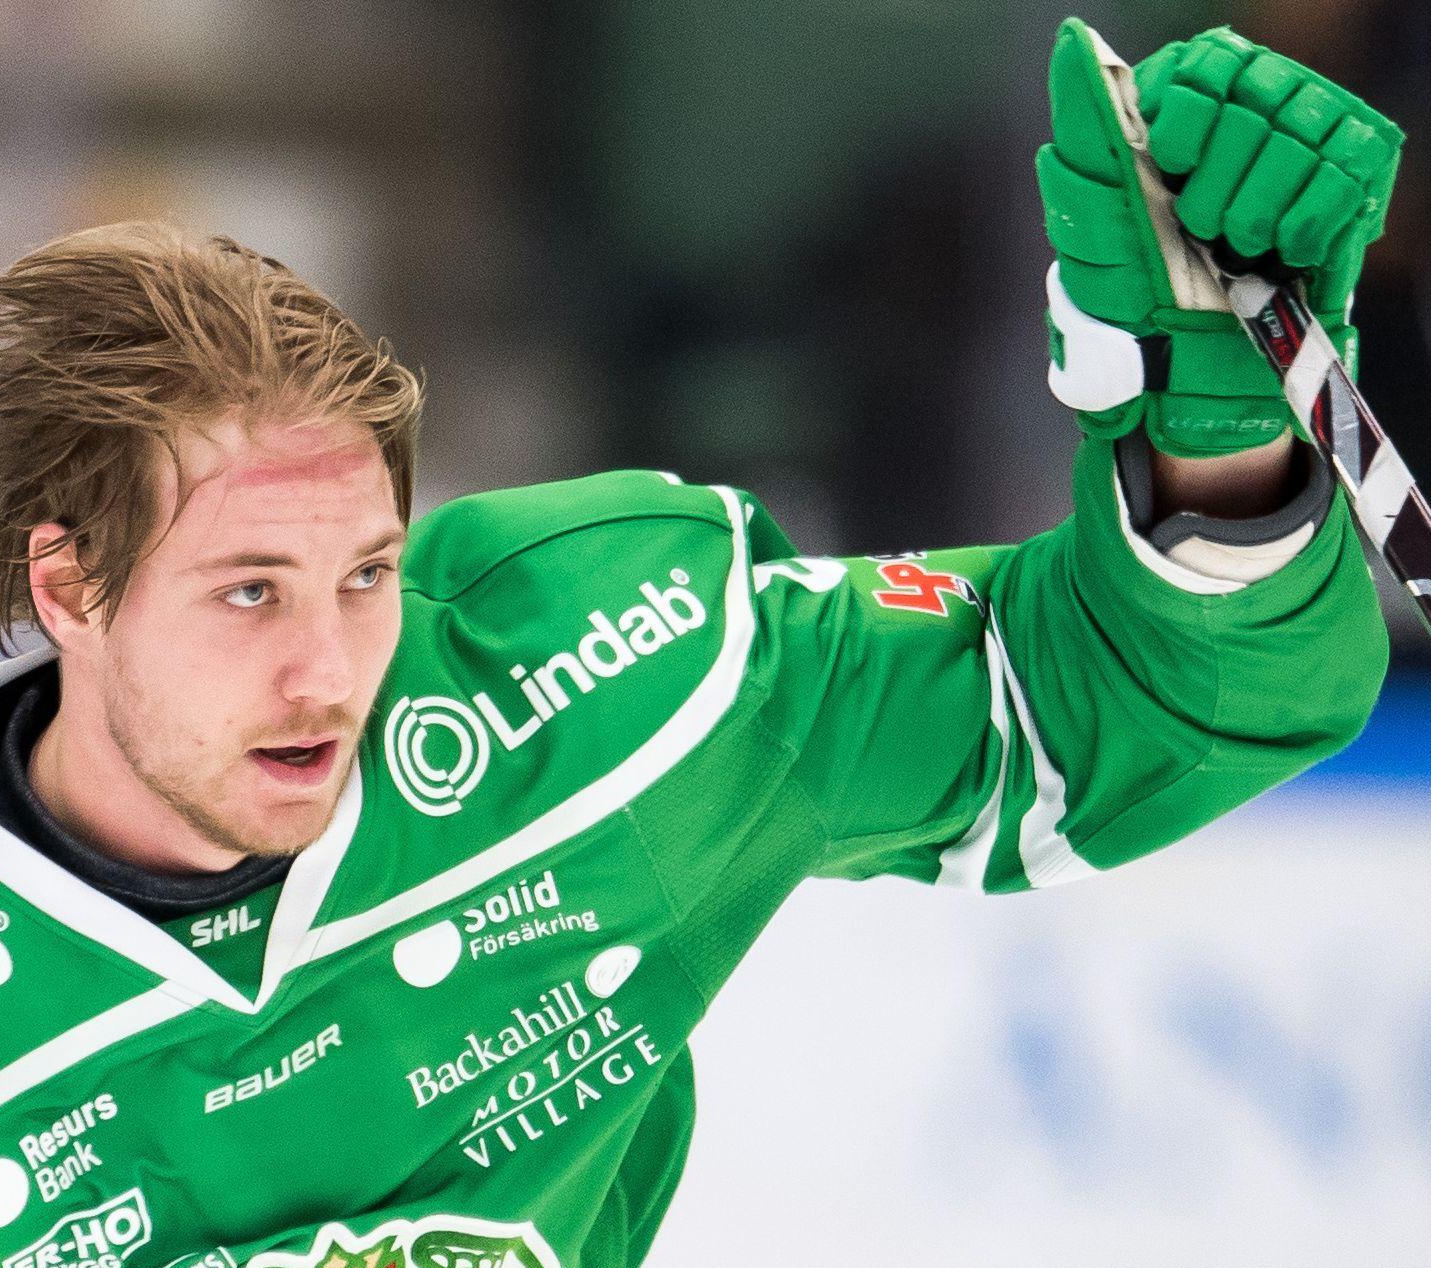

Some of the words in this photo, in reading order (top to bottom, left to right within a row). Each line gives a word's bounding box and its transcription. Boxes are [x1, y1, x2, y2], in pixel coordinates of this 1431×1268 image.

[475, 581, 705, 750] Lindab
[190, 902, 262, 947] SHL
[464, 869, 561, 932] Solid
[469, 907, 601, 961] Försäkring
[406, 979, 588, 1109] Backahill
[472, 1005, 621, 1127] MOTOR
[19, 1093, 118, 1169] Resurs
[463, 1033, 662, 1168] VILLAGE
[35, 1138, 103, 1203] Bank
